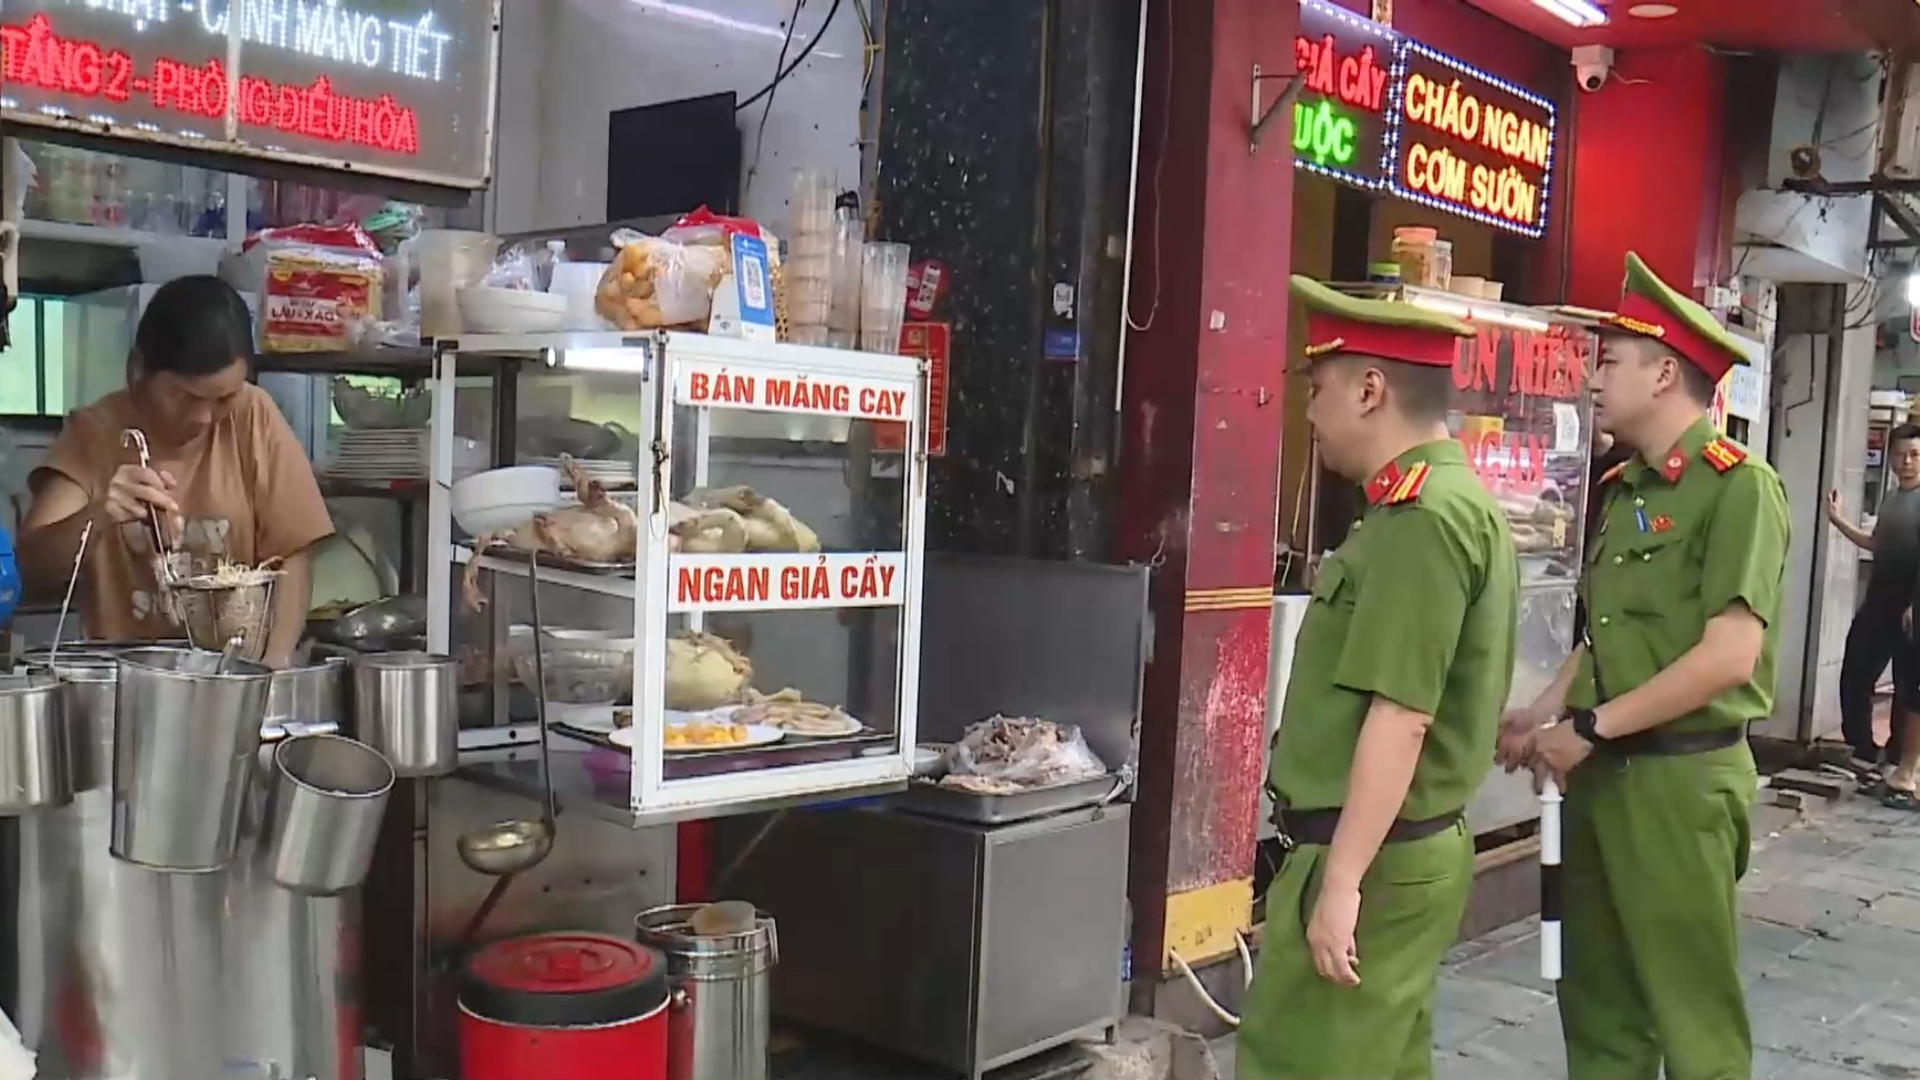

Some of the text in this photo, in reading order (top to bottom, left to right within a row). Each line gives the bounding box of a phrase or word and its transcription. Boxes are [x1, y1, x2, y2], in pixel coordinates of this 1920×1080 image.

[388, 9, 452, 82] TIẾT
[105, 51, 131, 100] 2
[351, 93, 417, 154] HÒA
[1294, 101, 1355, 164] UỘC
[1405, 74, 1549, 167] CHÁO NGAN
[1407, 143, 1536, 223] CƠM SƯỜN
[690, 368, 755, 404] BÁN
[765, 374, 850, 412] MĂNG
[858, 388, 906, 416] CAY
[677, 554, 895, 606] NGAN GIẢ CẦY
